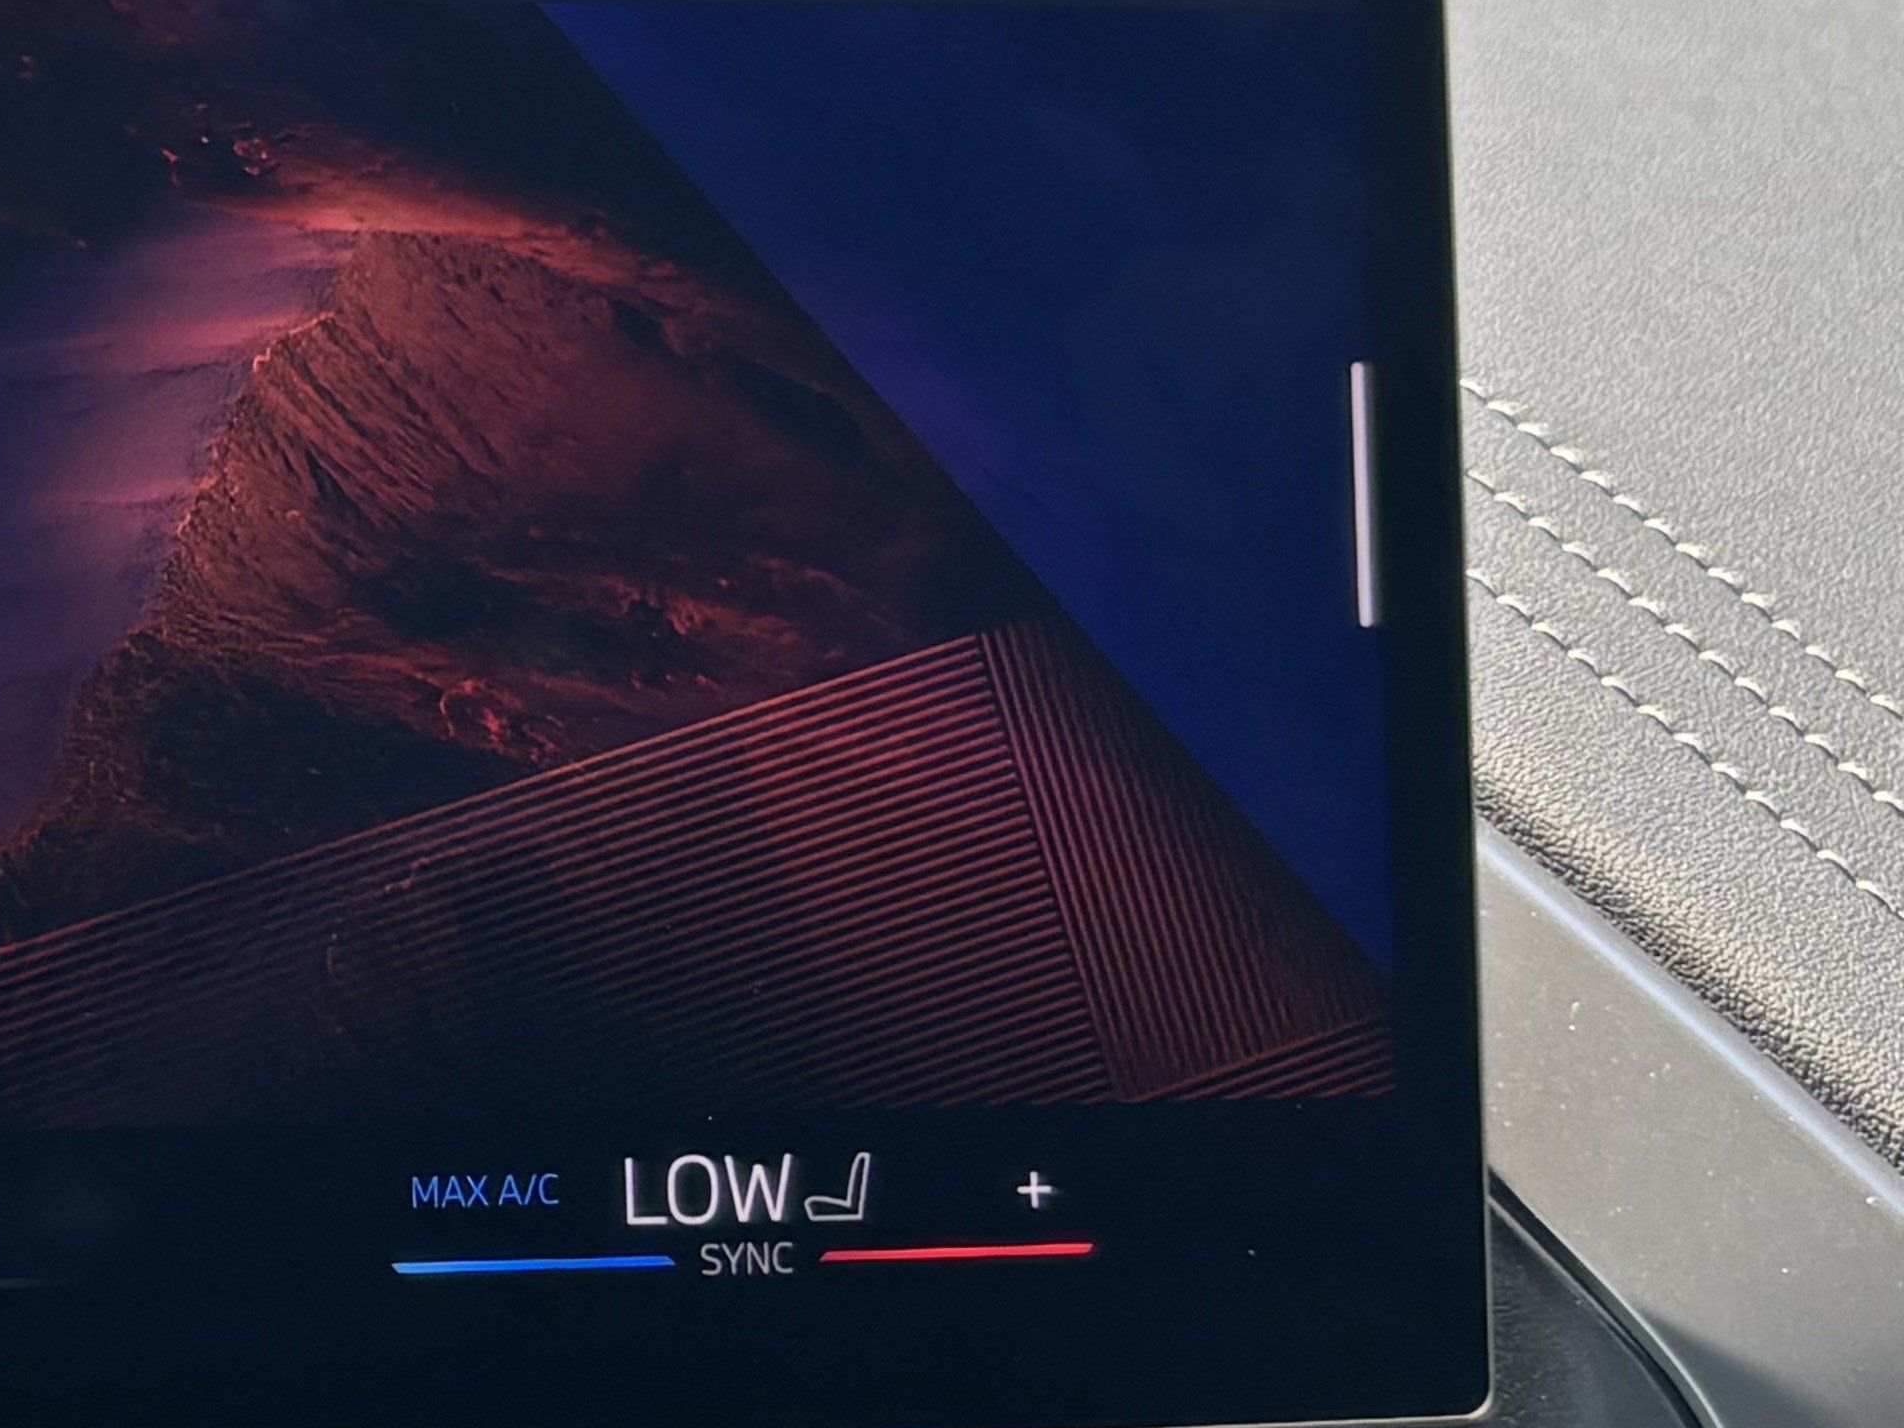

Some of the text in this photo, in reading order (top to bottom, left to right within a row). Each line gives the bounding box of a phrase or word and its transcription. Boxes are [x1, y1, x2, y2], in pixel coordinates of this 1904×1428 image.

[411, 1172, 560, 1209] MAX A/C
[624, 1153, 792, 1226] LOW
[700, 1241, 794, 1276] SYNC
